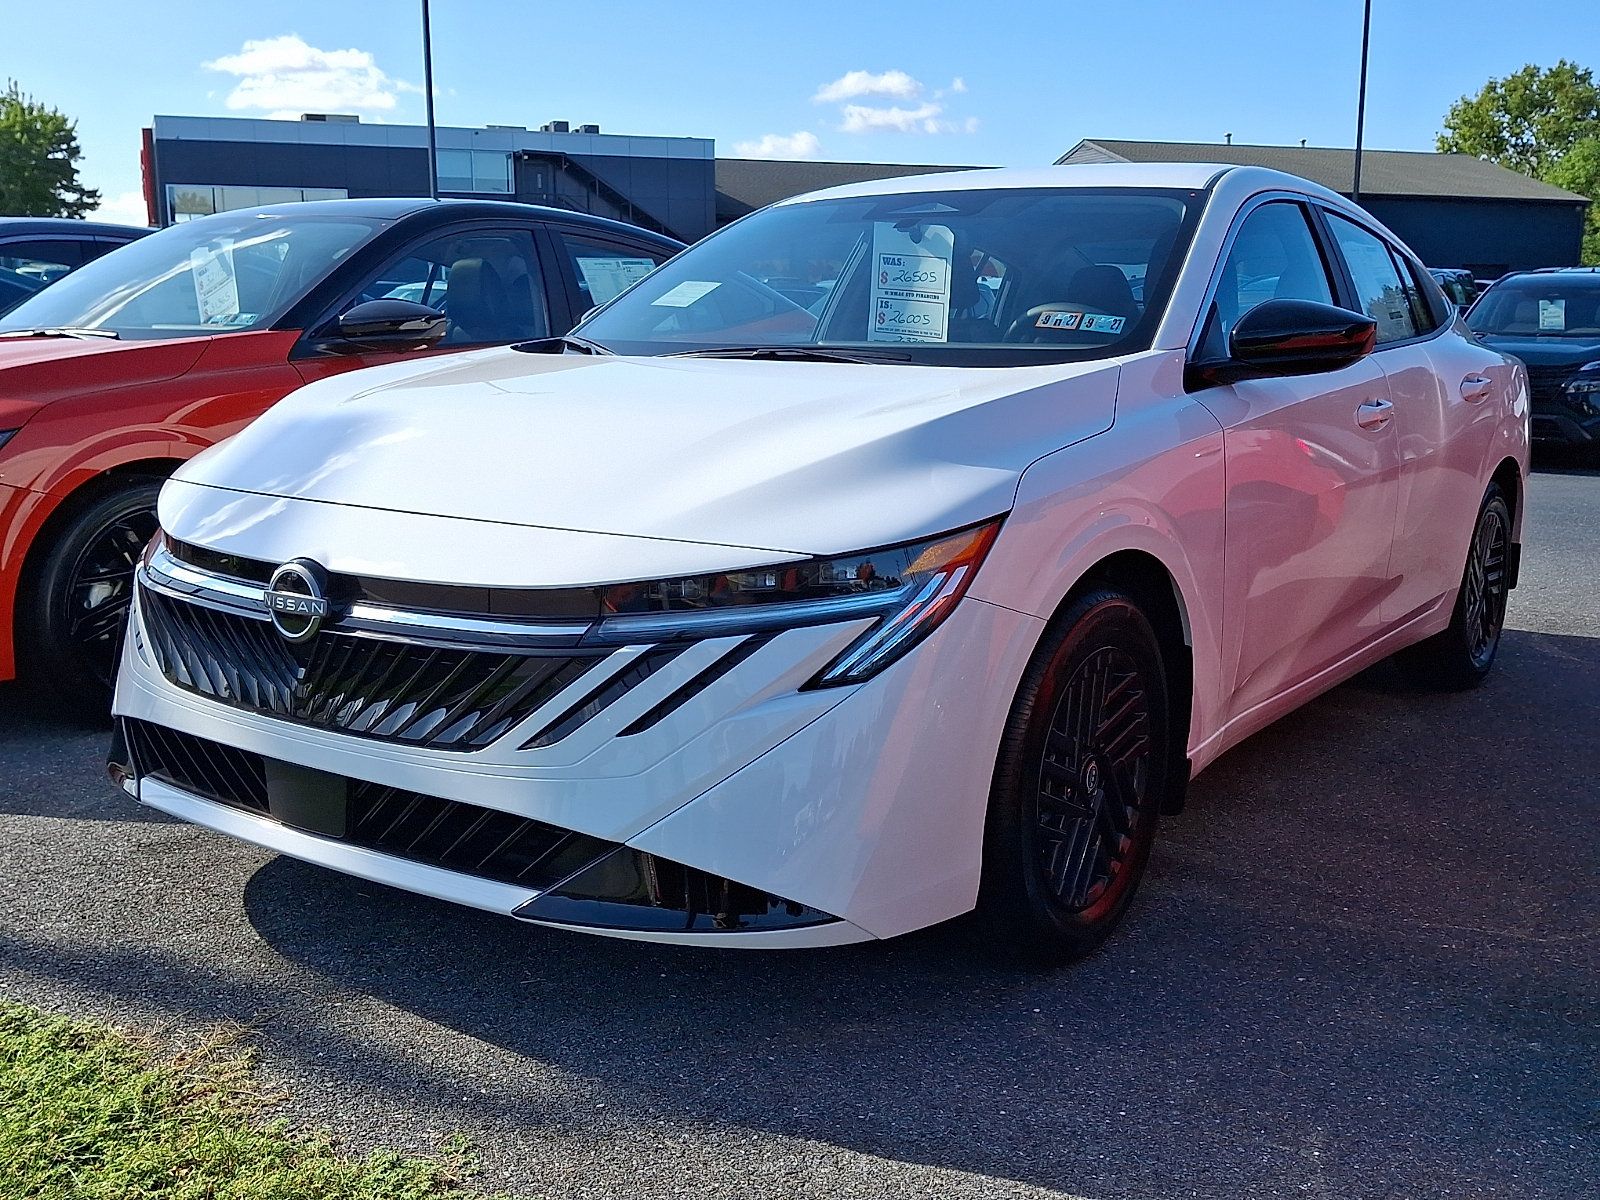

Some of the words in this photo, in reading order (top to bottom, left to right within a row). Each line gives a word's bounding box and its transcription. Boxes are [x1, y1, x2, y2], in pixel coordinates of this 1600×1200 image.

[882, 256, 906, 267] WAS:
[880, 270, 889, 285] $
[892, 269, 937, 283] 26505
[879, 300, 893, 309] IS:
[877, 311, 886, 325] $
[888, 310, 931, 325] 26005
[1066, 315, 1078, 327] 27
[263, 593, 324, 613] NISSAN
